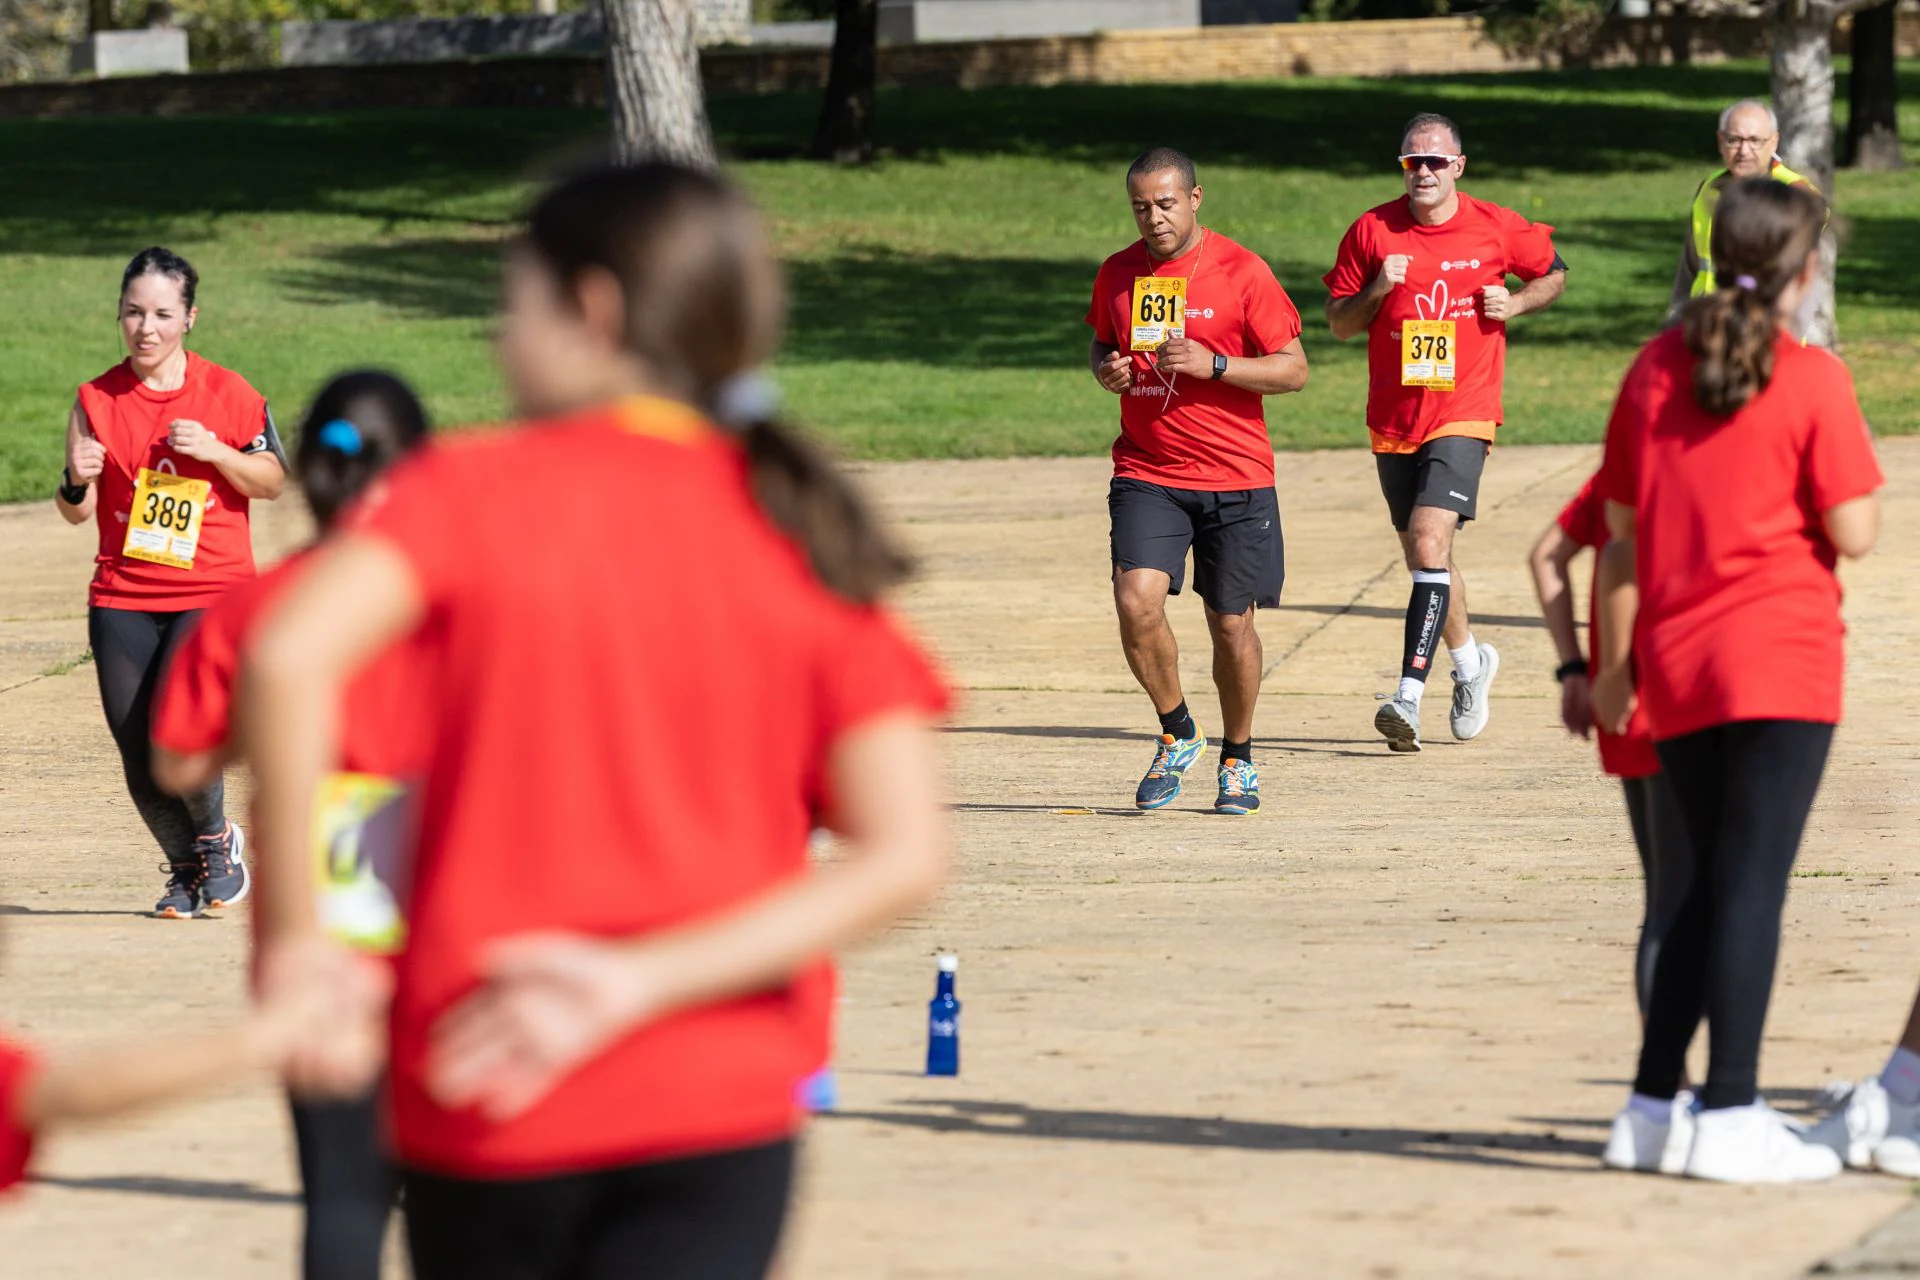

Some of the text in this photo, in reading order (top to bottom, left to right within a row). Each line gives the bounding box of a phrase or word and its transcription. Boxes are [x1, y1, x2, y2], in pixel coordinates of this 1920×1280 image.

[1140, 294, 1176, 323] 631
[1411, 335, 1447, 360] 378
[142, 492, 192, 532] 389
